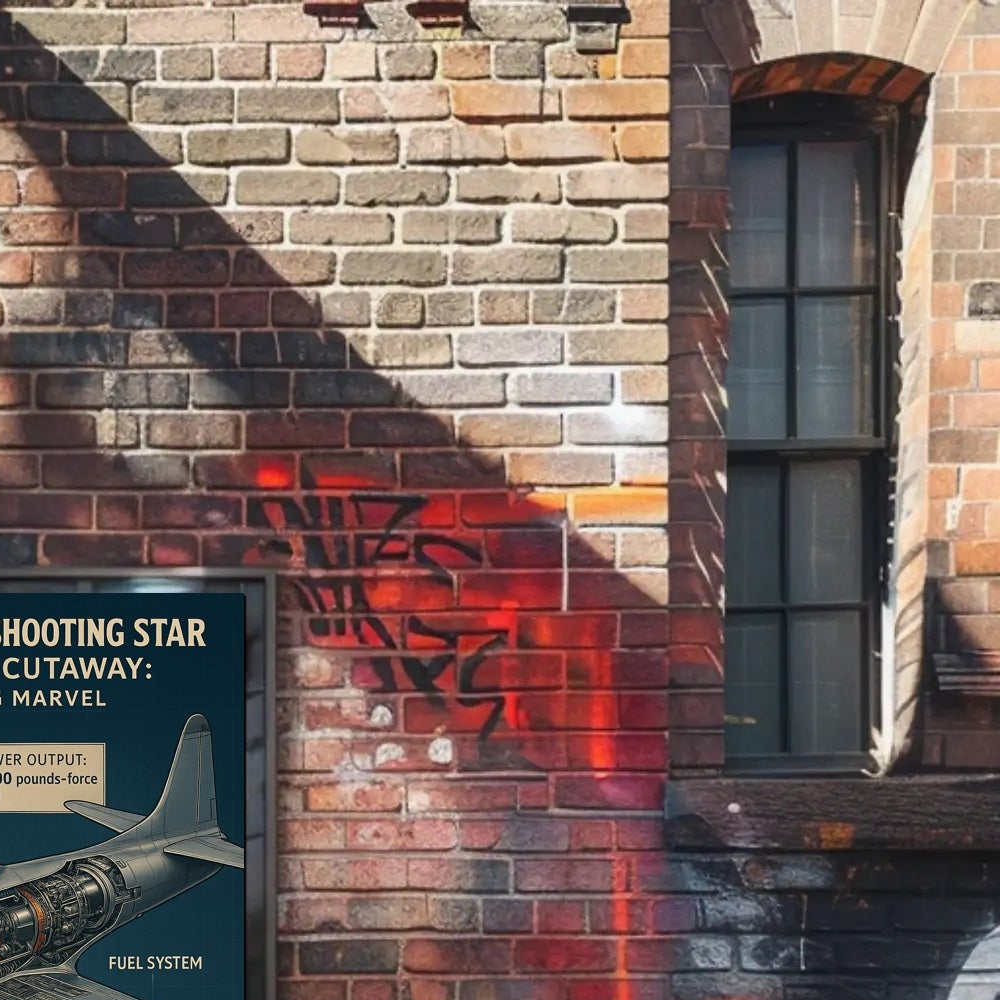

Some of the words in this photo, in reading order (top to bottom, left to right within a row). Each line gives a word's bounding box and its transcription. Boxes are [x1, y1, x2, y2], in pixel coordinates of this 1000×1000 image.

[133, 617, 207, 647] STAR
[2, 656, 152, 680] CUTAWAY:
[12, 689, 107, 707] MARVEL
[26, 753, 87, 766] OUTPUT:
[16, 771, 98, 788] pounds-force
[109, 956, 144, 970] FUEL
[147, 955, 203, 970] SYSTEM
